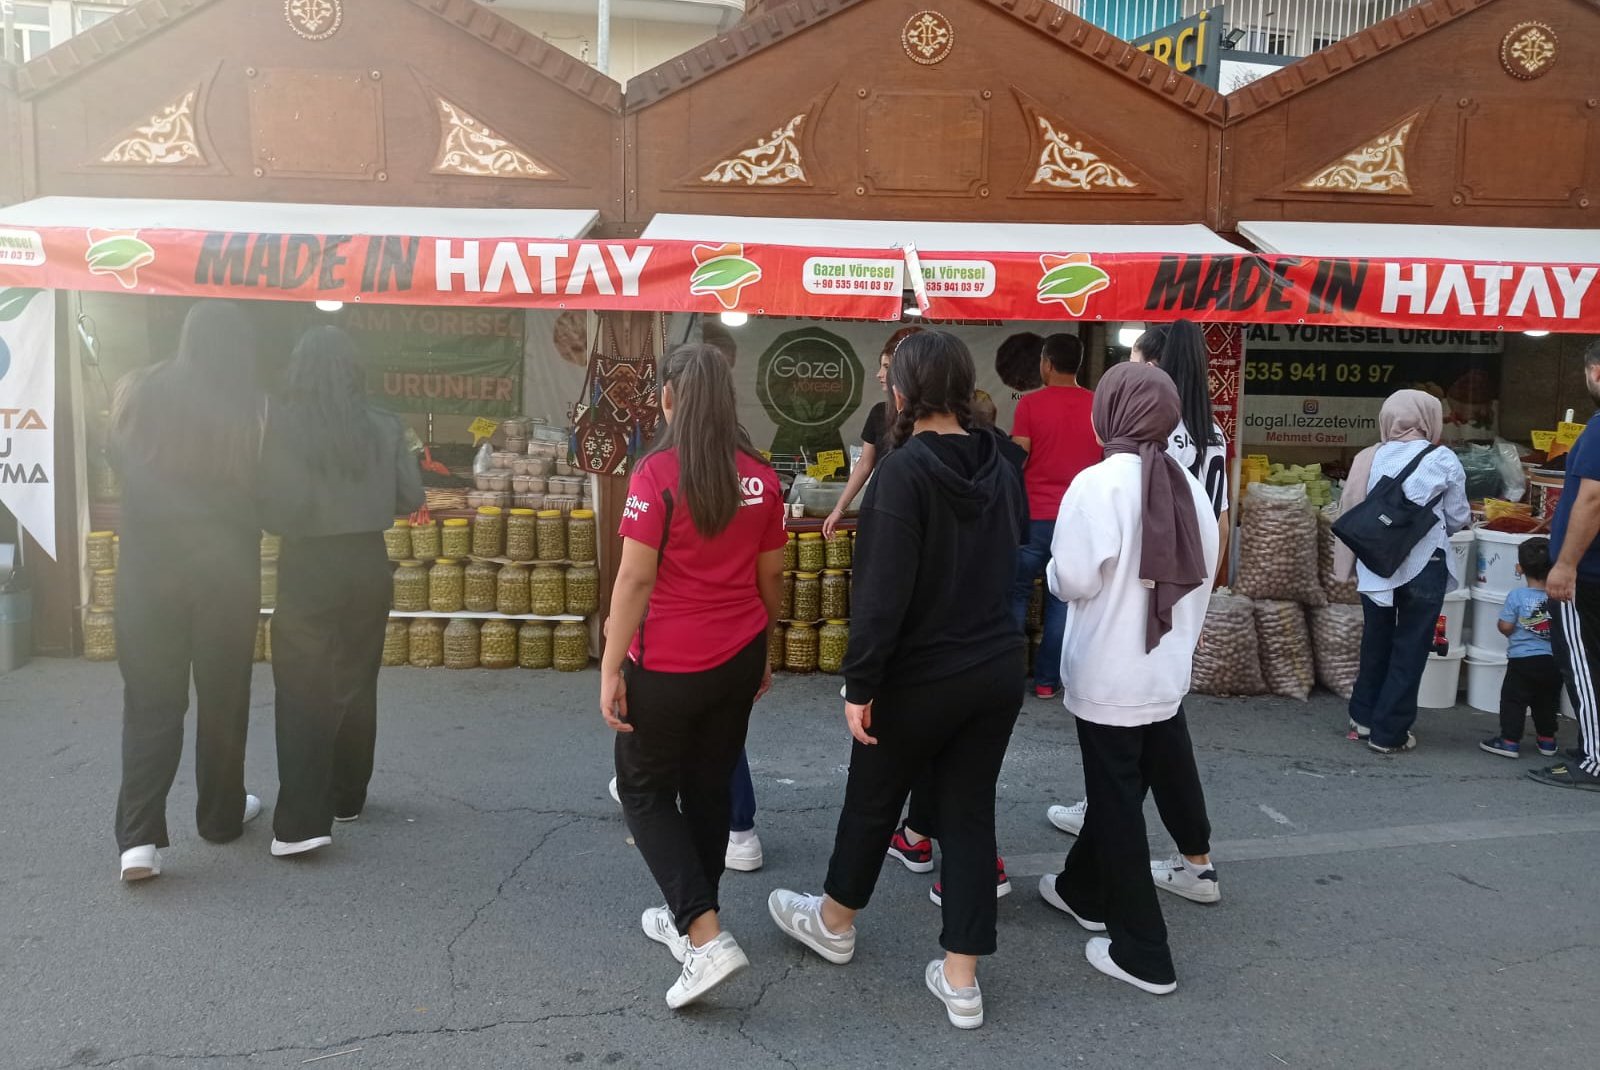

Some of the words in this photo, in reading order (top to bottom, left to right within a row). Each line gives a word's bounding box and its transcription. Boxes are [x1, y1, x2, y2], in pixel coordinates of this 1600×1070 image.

[195, 233, 352, 290] MADE
[360, 235, 419, 292] IN
[435, 240, 654, 297] HATAY
[813, 263, 846, 277] Gazel
[849, 264, 895, 278] Yöresel
[940, 266, 986, 280] Yöresel
[835, 280, 851, 290] 535
[854, 281, 868, 290] 941
[870, 281, 881, 290] 03
[883, 281, 894, 291] 97
[925, 282, 942, 291] 535
[944, 282, 959, 292] 941
[961, 282, 972, 291] 03
[974, 282, 985, 292] 97
[1144, 255, 1300, 312] MADE
[1307, 258, 1369, 314] IN
[1380, 262, 1598, 319] HATAY
[773, 354, 844, 380] Gazel
[1245, 361, 1284, 381] 535
[1290, 362, 1328, 382] 941
[1335, 363, 1362, 383] 03
[1368, 364, 1395, 383] 97
[1244, 413, 1376, 430] dogal.lezzetevim
[1266, 431, 1312, 442] Mehmet
[1315, 433, 1348, 443] Gazel
